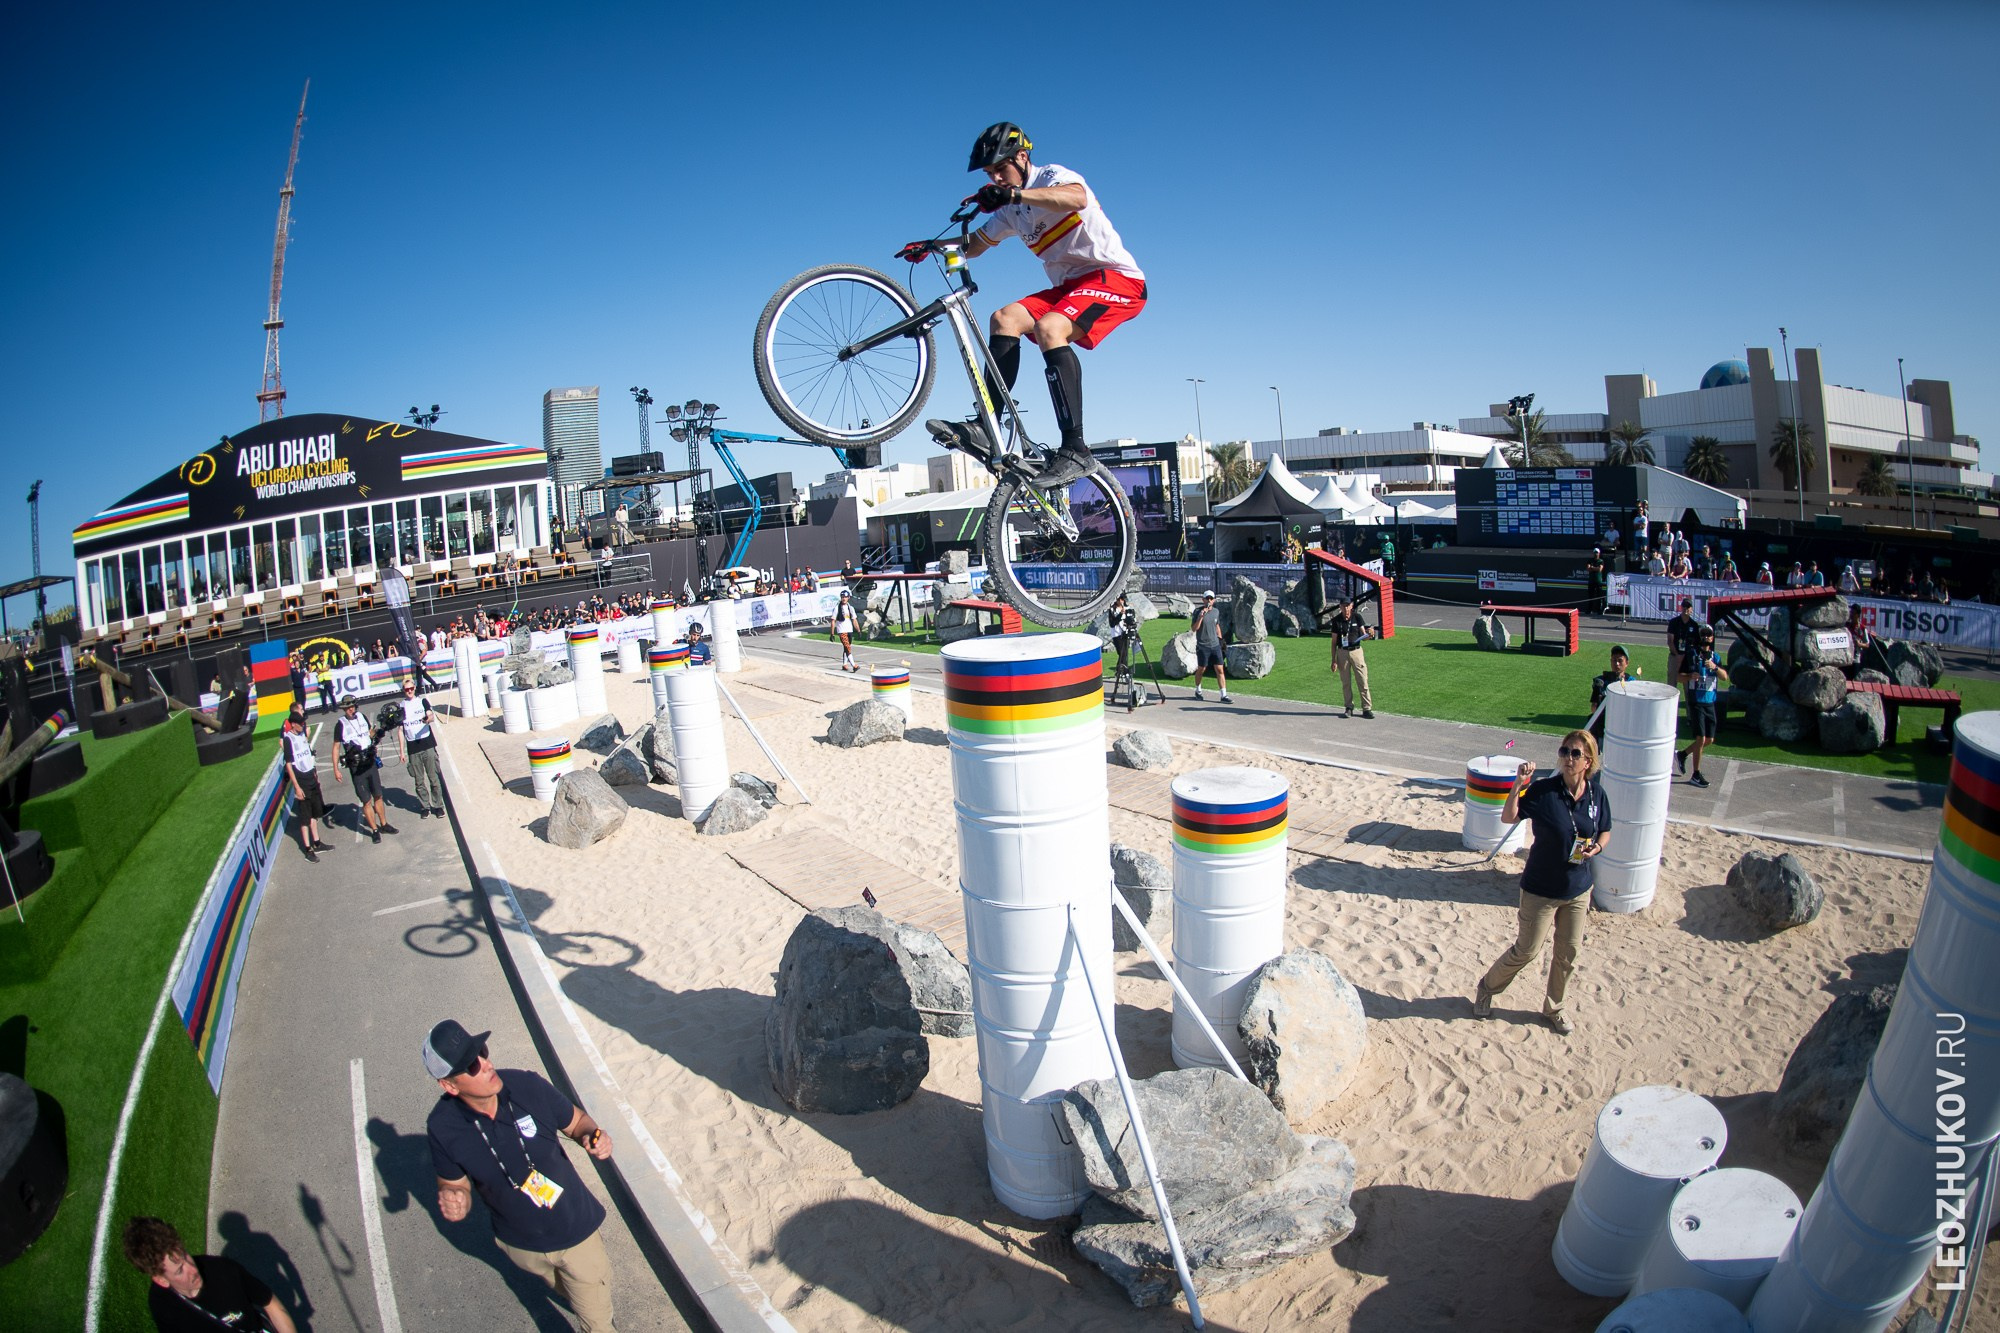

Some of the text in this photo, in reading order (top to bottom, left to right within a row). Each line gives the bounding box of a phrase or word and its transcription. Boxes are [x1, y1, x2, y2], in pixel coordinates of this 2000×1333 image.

[236, 433, 336, 477] ABU DHABI
[250, 457, 349, 488] UCI URBAN CYCLING
[256, 471, 356, 500] WORLD CHAMPIONSHIPS
[1080, 548, 1113, 559] ABU DHABI
[1025, 571, 1086, 585] SHIMANO
[1481, 571, 1496, 579] UCI
[1879, 608, 1964, 636] TISSOT
[1826, 636, 1847, 644] TISSOT
[247, 823, 267, 882] UCI
